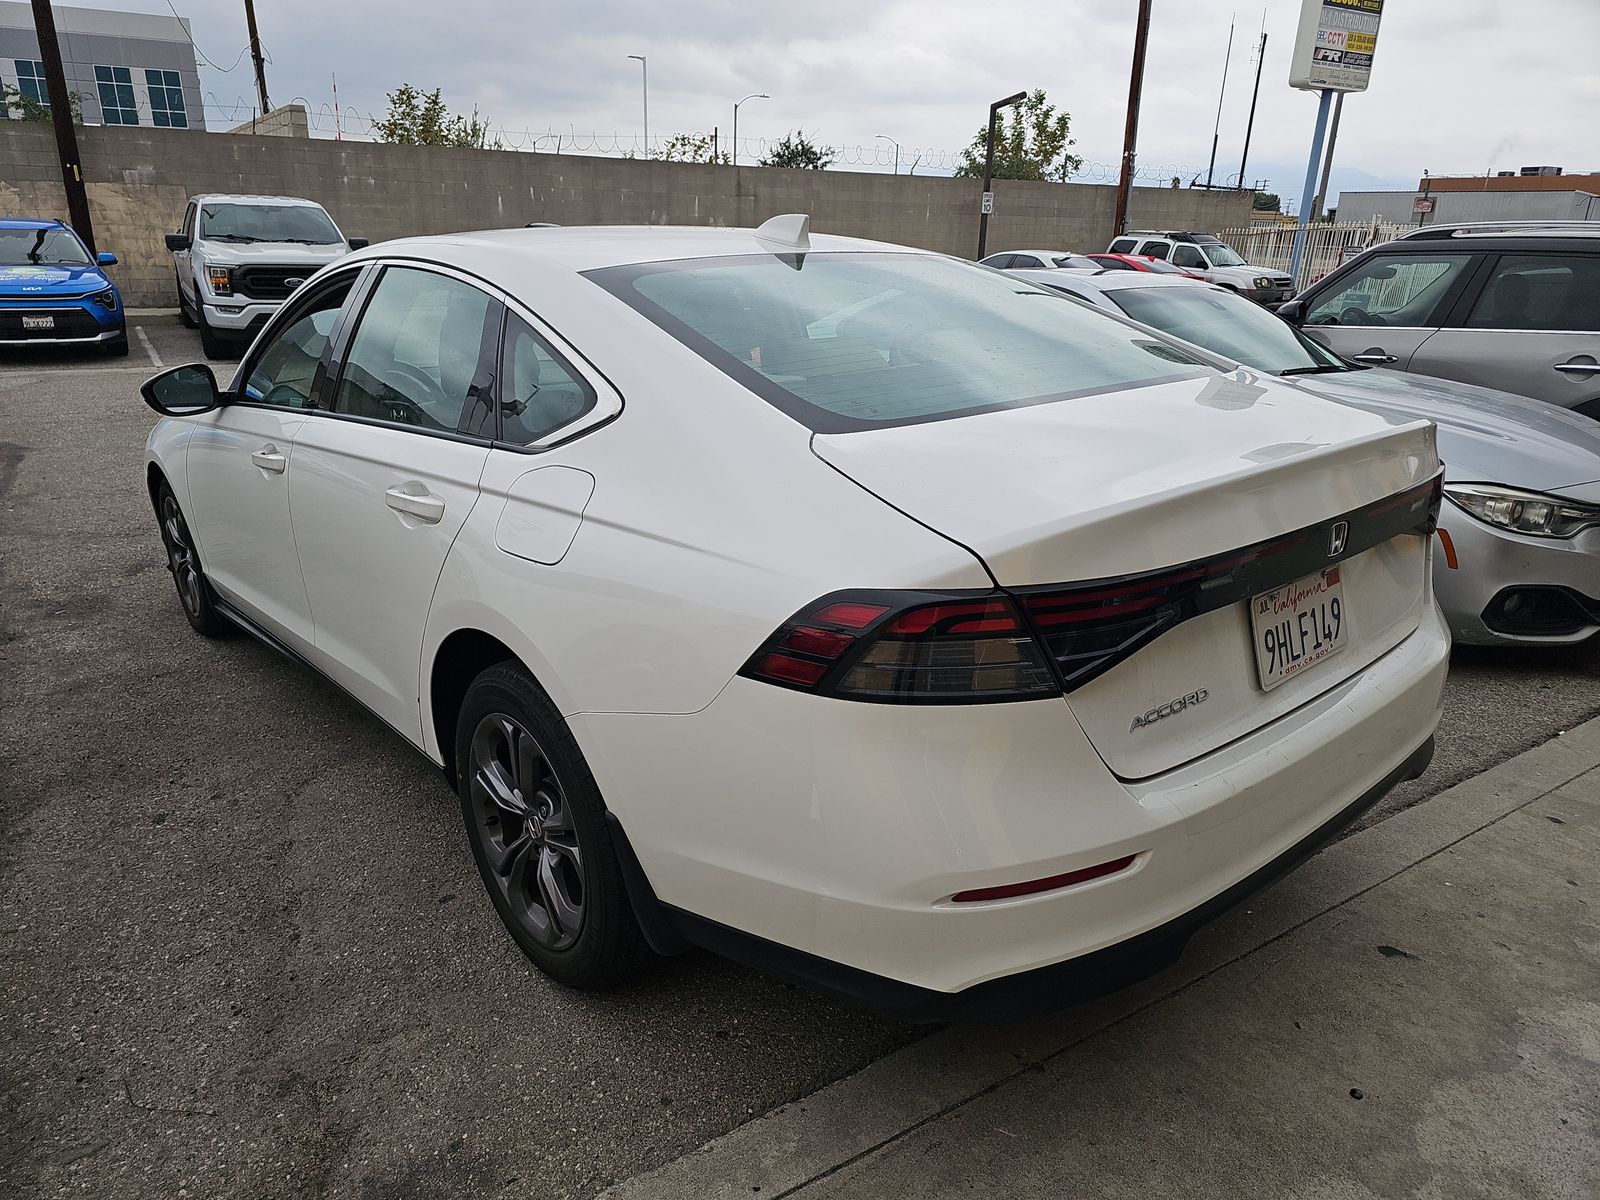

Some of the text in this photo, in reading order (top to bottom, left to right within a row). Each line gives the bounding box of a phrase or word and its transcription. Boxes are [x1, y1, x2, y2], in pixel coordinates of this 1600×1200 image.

[1328, 31, 1345, 46] CCTV
[984, 204, 991, 212] 10
[1273, 580, 1327, 615] California
[1264, 597, 1340, 675] 9HLF149
[1285, 648, 1329, 674] dmv.ca.gov
[1129, 687, 1209, 733] ACCORD
